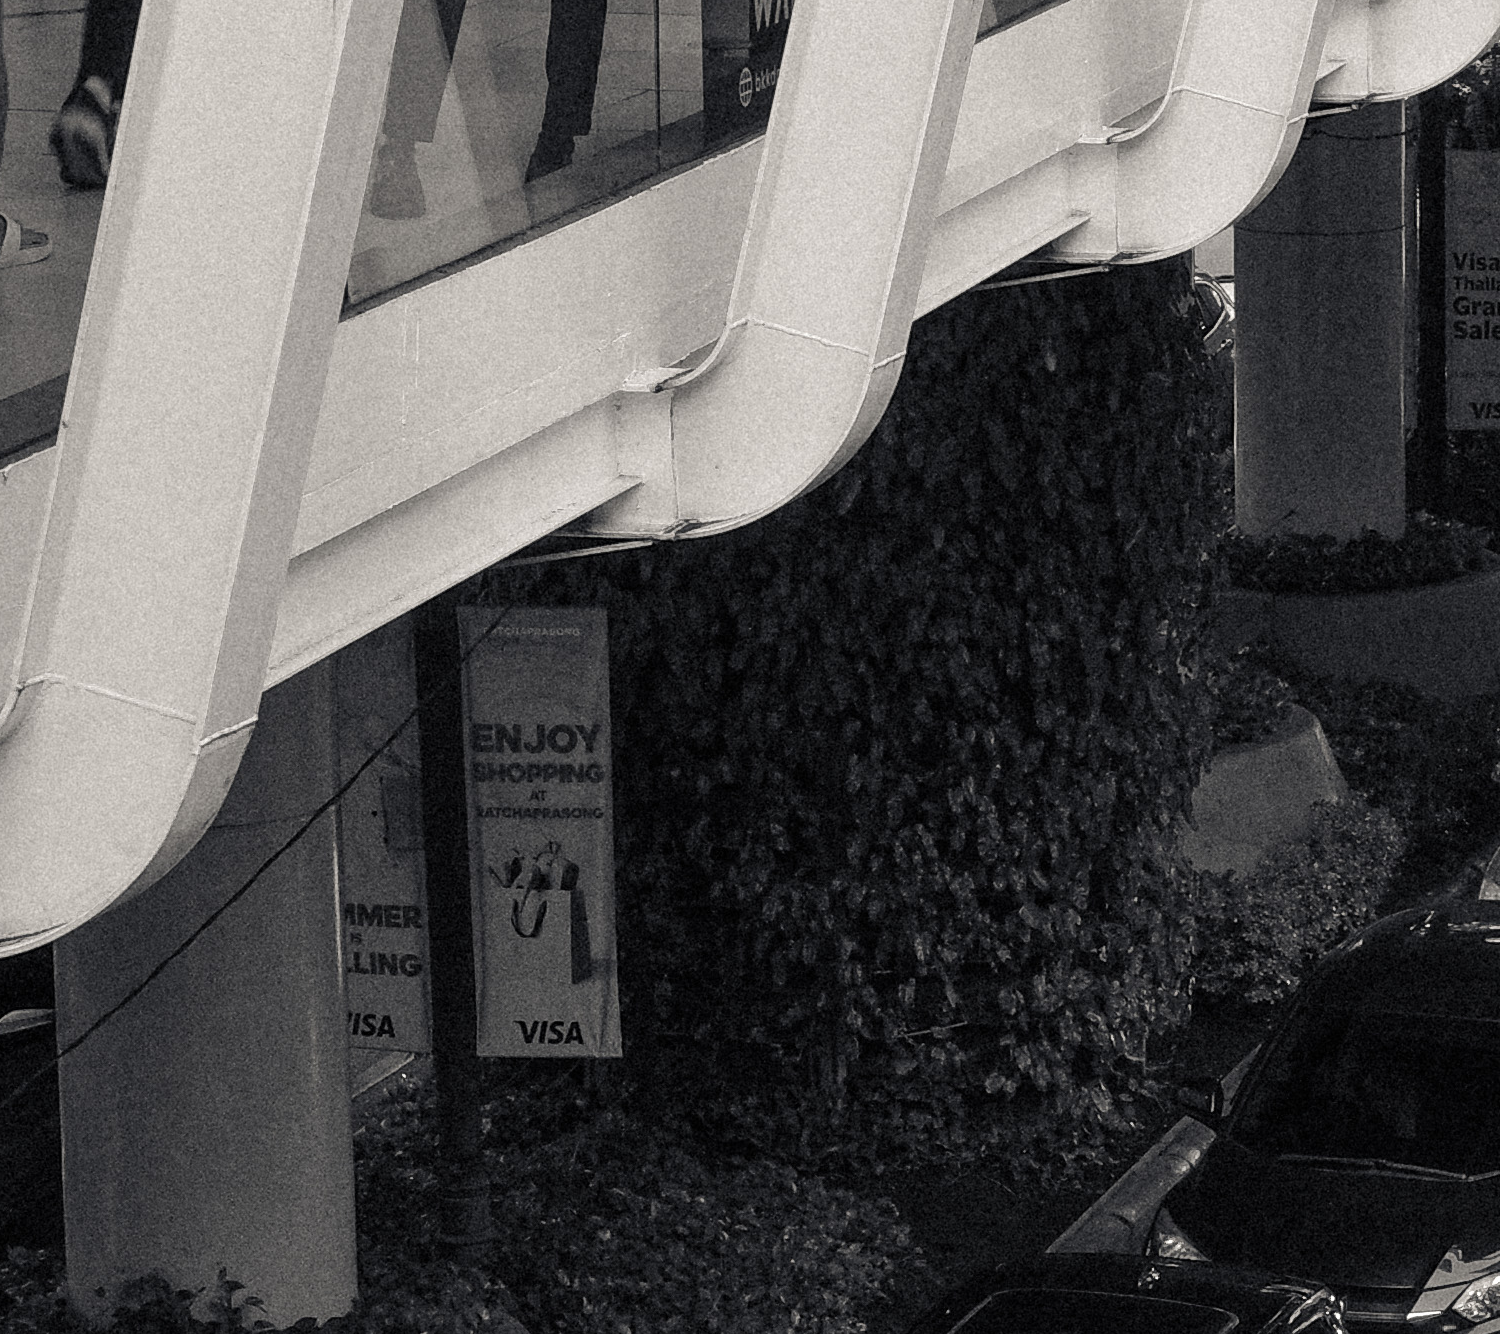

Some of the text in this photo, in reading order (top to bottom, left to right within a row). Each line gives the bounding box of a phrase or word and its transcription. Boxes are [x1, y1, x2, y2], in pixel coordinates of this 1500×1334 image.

[1452, 251, 1500, 272] Visa
[471, 723, 602, 754] ENJOY
[470, 762, 605, 784] SHOPPING
[529, 789, 547, 802] AT
[348, 952, 423, 977] LING
[348, 1012, 397, 1039] ISA
[513, 1019, 585, 1046] VISA
